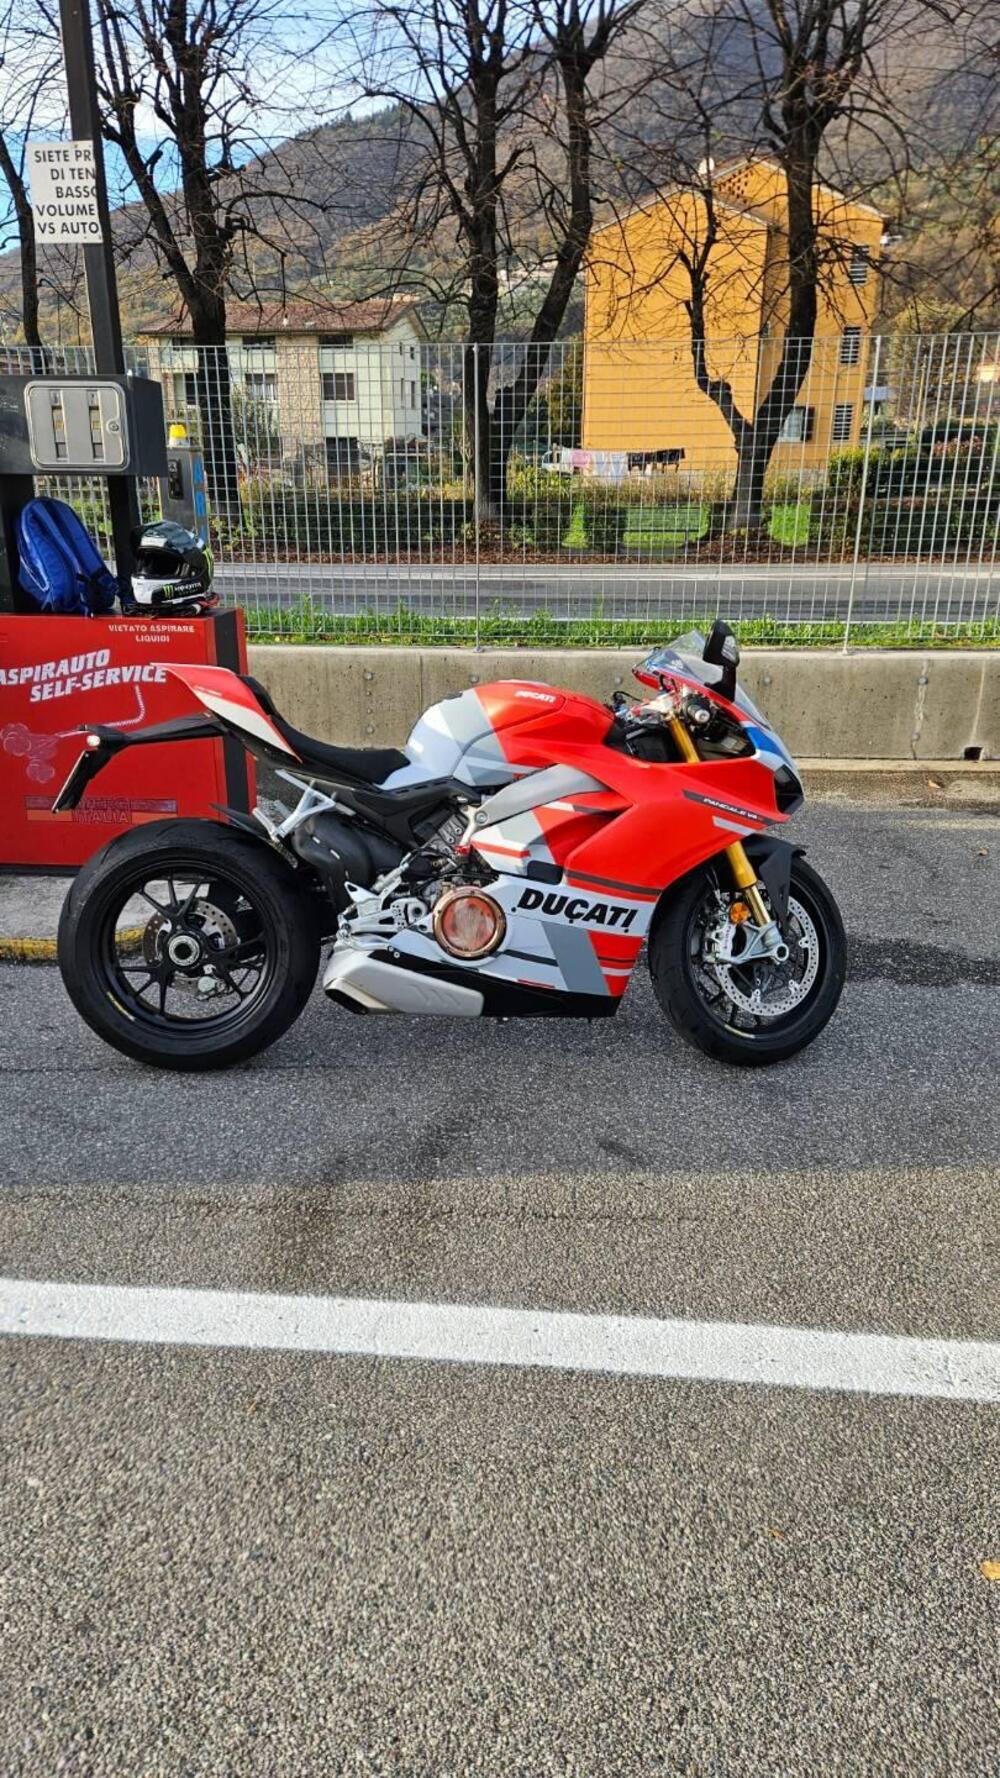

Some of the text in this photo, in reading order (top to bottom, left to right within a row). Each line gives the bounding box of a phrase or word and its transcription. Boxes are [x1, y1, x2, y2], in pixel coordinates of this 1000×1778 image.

[34, 150, 70, 163] SIETE
[50, 168, 65, 180] DI
[35, 204, 95, 217] VOLUME
[37, 222, 100, 234] VS AUTO
[108, 624, 195, 633] VIETATO ASPIRARE
[135, 635, 170, 643] LIQUIDI
[30, 665, 168, 702] SELF-SERVICE
[517, 887, 639, 930] DUCATI
